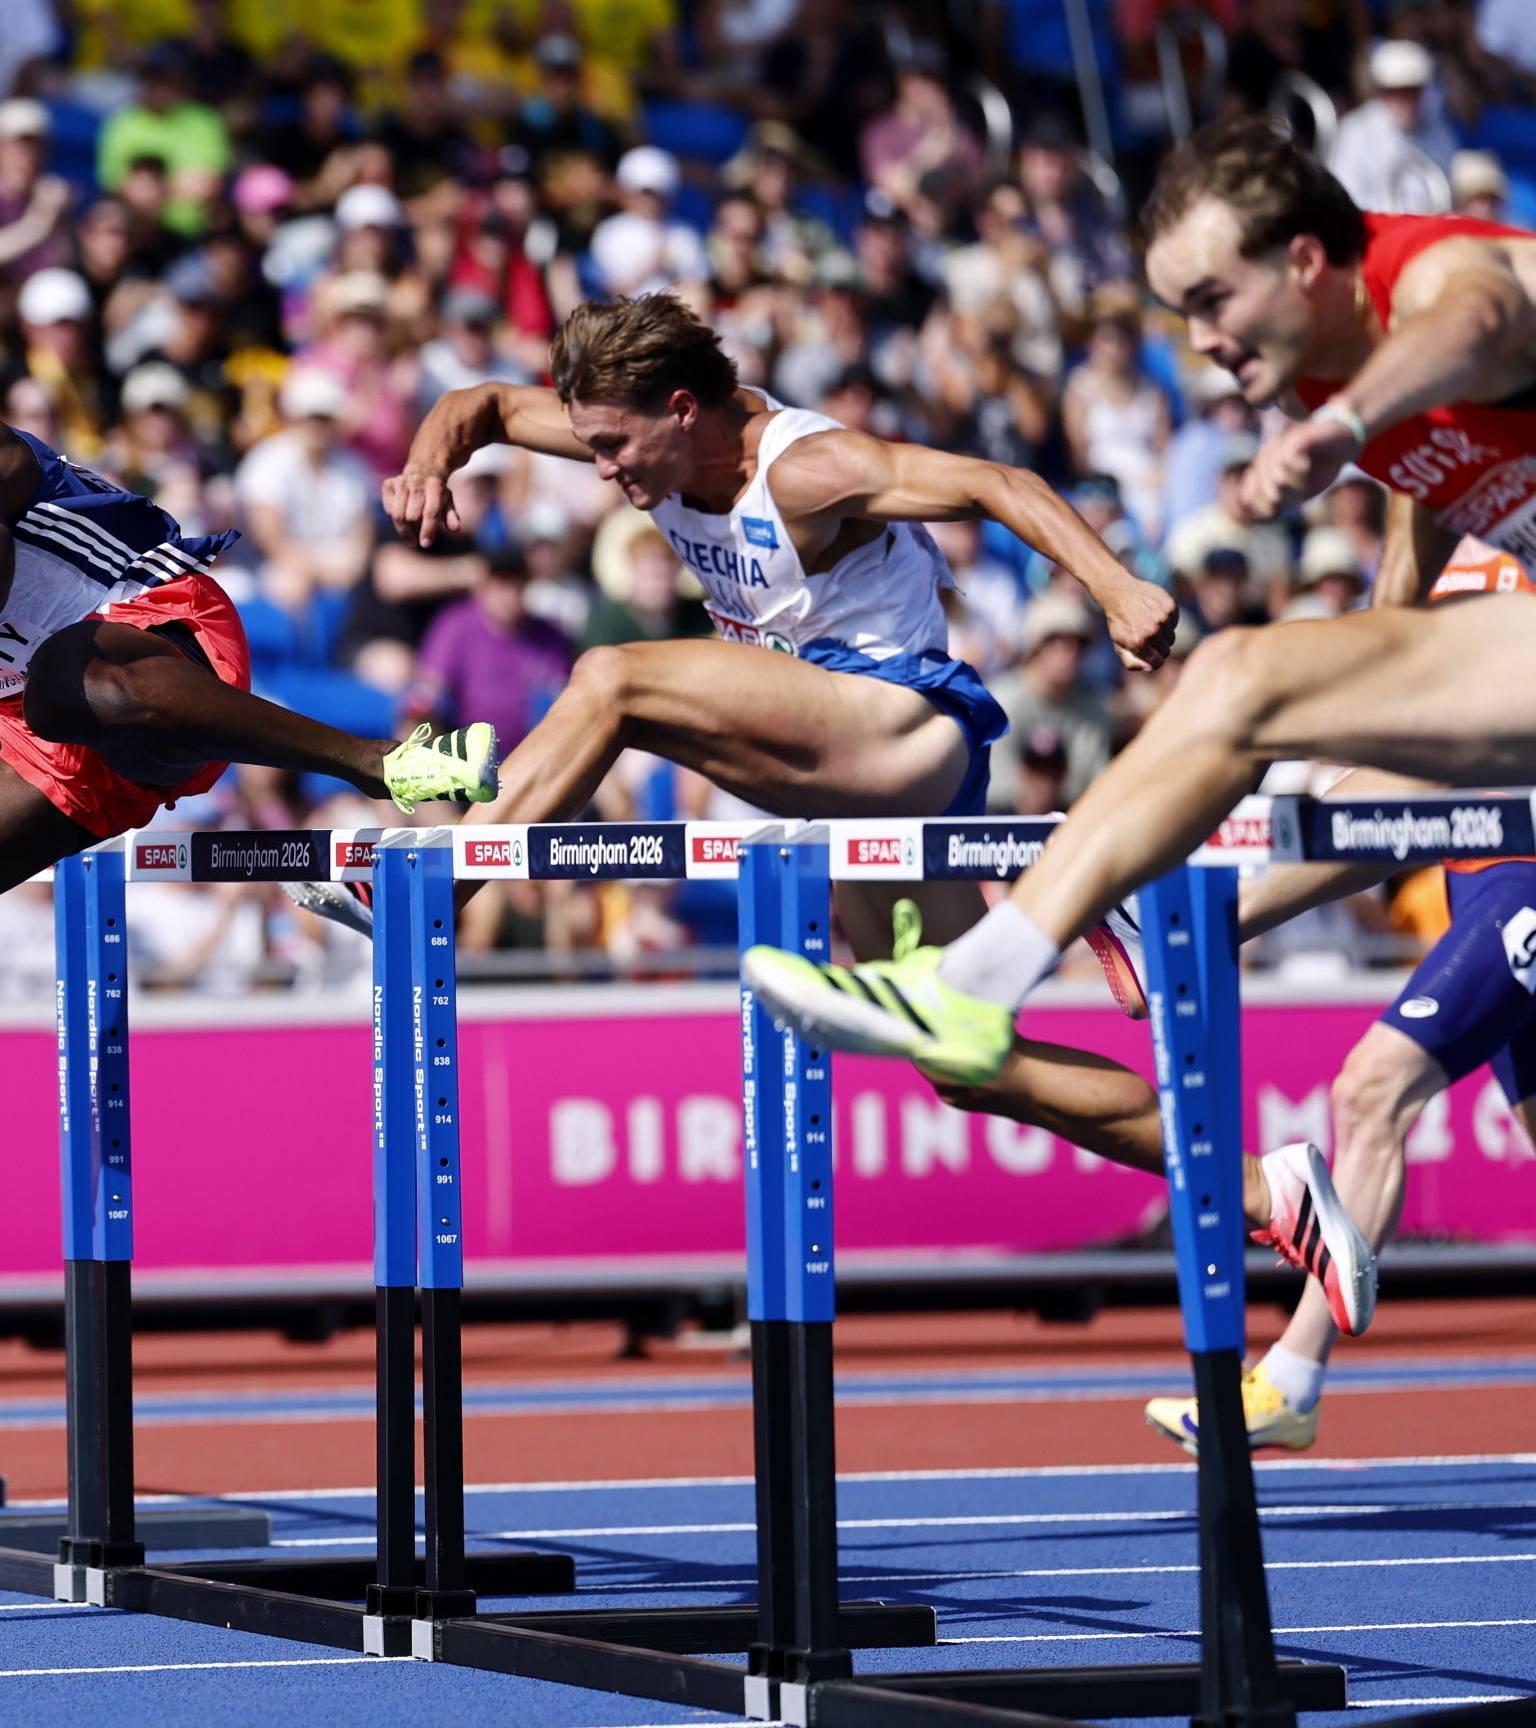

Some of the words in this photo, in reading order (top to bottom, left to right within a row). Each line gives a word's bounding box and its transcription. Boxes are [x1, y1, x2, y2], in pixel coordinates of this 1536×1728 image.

[669, 529, 770, 589] CZECHIA
[1331, 807, 1450, 861] Birmingham
[1450, 805, 1504, 849] 2026
[144, 848, 177, 865] SPAR
[211, 842, 279, 876] Birmingham
[280, 842, 311, 868] 2026
[344, 846, 372, 864] SPA
[474, 845, 511, 863] SPAR
[550, 836, 628, 874] Birmingham
[629, 835, 664, 865] 2026
[857, 841, 902, 864] SPAR
[948, 833, 1044, 878] Birmingham
[104, 934, 121, 943] 686
[431, 936, 448, 946] 686
[105, 989, 121, 998] 762
[432, 996, 449, 1006] 762
[56, 980, 66, 1050] Nordic
[87, 980, 98, 1051] Nordic
[374, 986, 383, 1060] Nordic
[413, 986, 424, 1062] Nordic
[741, 990, 753, 1074] Nordic
[106, 1045, 122, 1054] 838
[433, 1056, 451, 1066] 838
[784, 1027, 795, 1077] rdic
[58, 1056, 68, 1115] Sport
[89, 1056, 100, 1116] Sport
[107, 1099, 124, 1108] 914
[373, 1068, 383, 1130] Sport
[414, 1068, 425, 1132] Sport
[435, 1114, 452, 1124] 914
[743, 1080, 755, 1150] Sport
[784, 1082, 797, 1153] Sport
[806, 1132, 825, 1143] 914
[109, 1155, 124, 1164] 991
[436, 1175, 453, 1184] 991
[108, 1210, 129, 1219] 1067
[807, 1197, 825, 1209] 991
[436, 1234, 457, 1244] 1067
[806, 1262, 829, 1273] 1067
